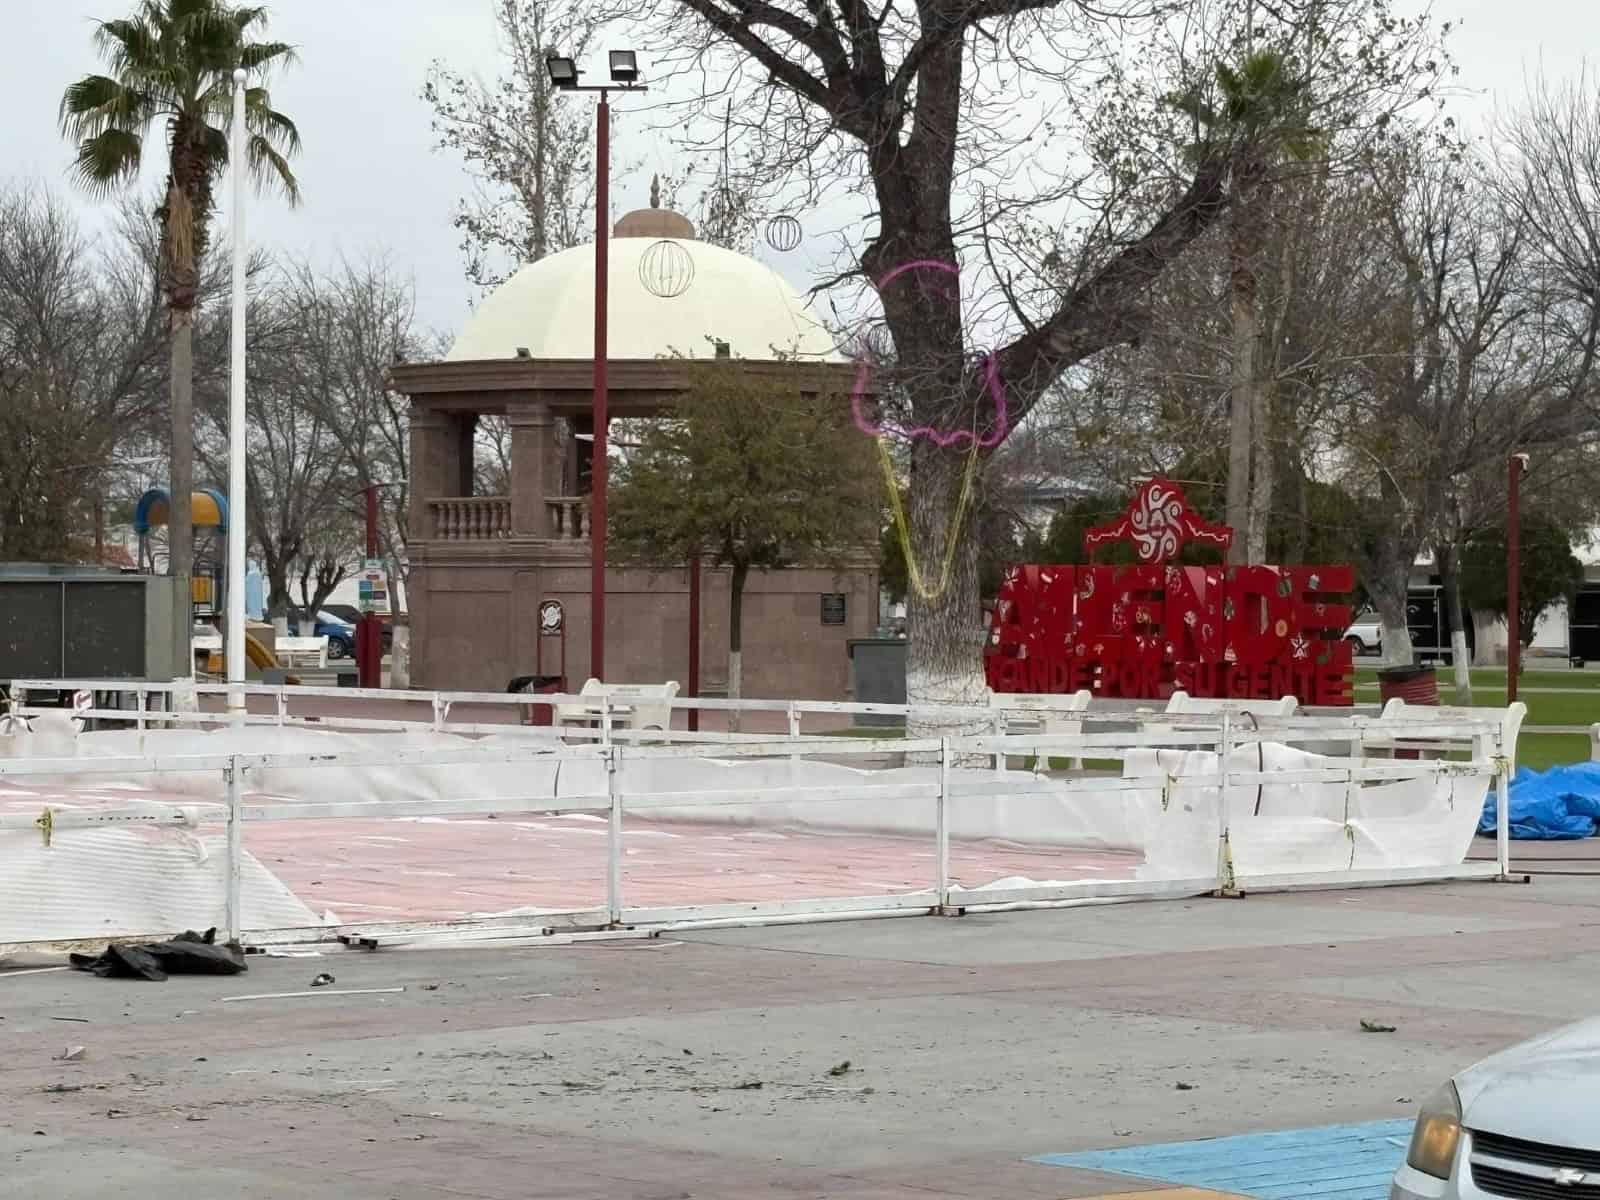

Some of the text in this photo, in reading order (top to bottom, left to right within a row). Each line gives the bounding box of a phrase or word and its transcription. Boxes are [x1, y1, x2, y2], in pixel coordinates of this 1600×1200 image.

[987, 655, 1093, 694] RANDE
[1175, 662, 1217, 698] SU
[1226, 662, 1354, 706] GENTE
